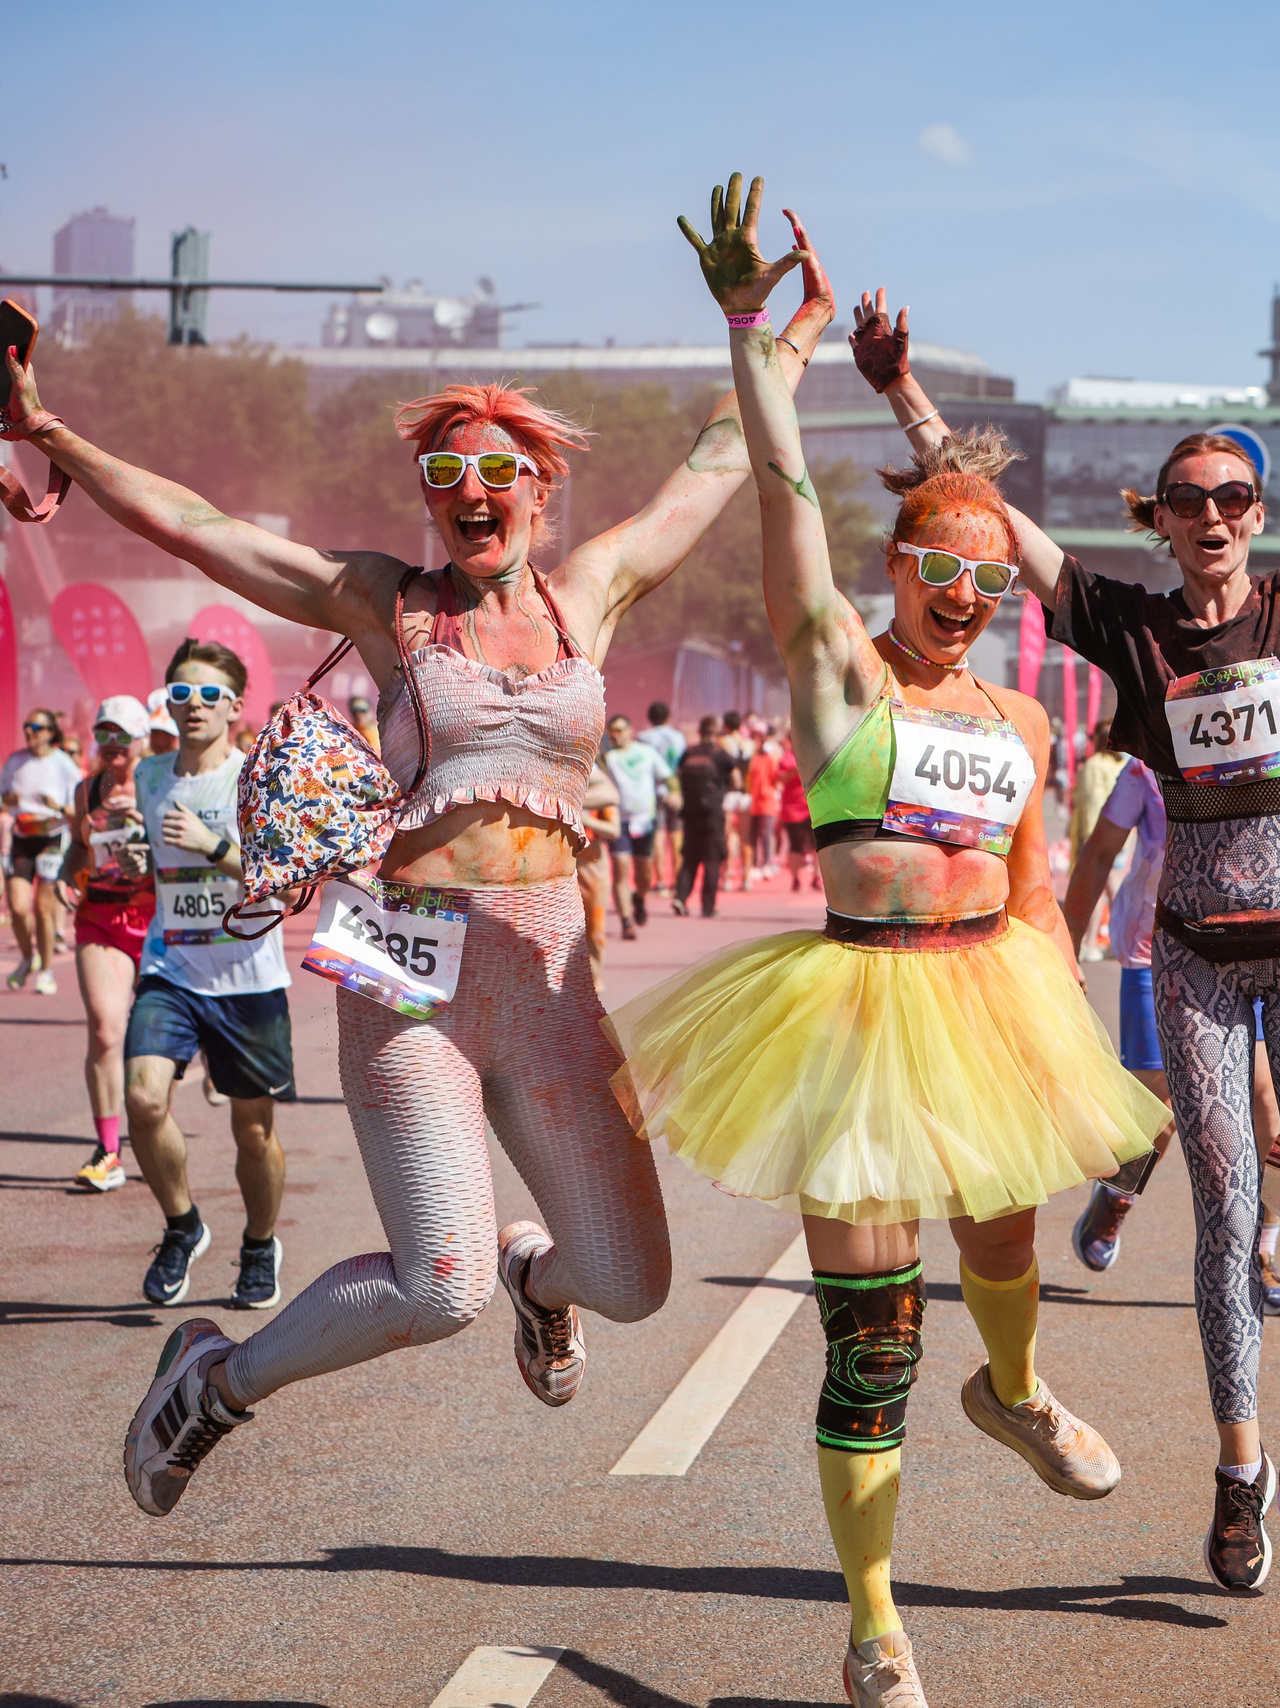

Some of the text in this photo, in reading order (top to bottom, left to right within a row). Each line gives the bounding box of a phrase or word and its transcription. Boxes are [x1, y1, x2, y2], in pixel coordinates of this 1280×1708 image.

[1189, 699, 1278, 749] 4371
[914, 744, 1017, 803] 4054
[173, 893, 226, 918] 4805
[400, 903, 464, 924] 2026
[338, 904, 439, 977] 4285
